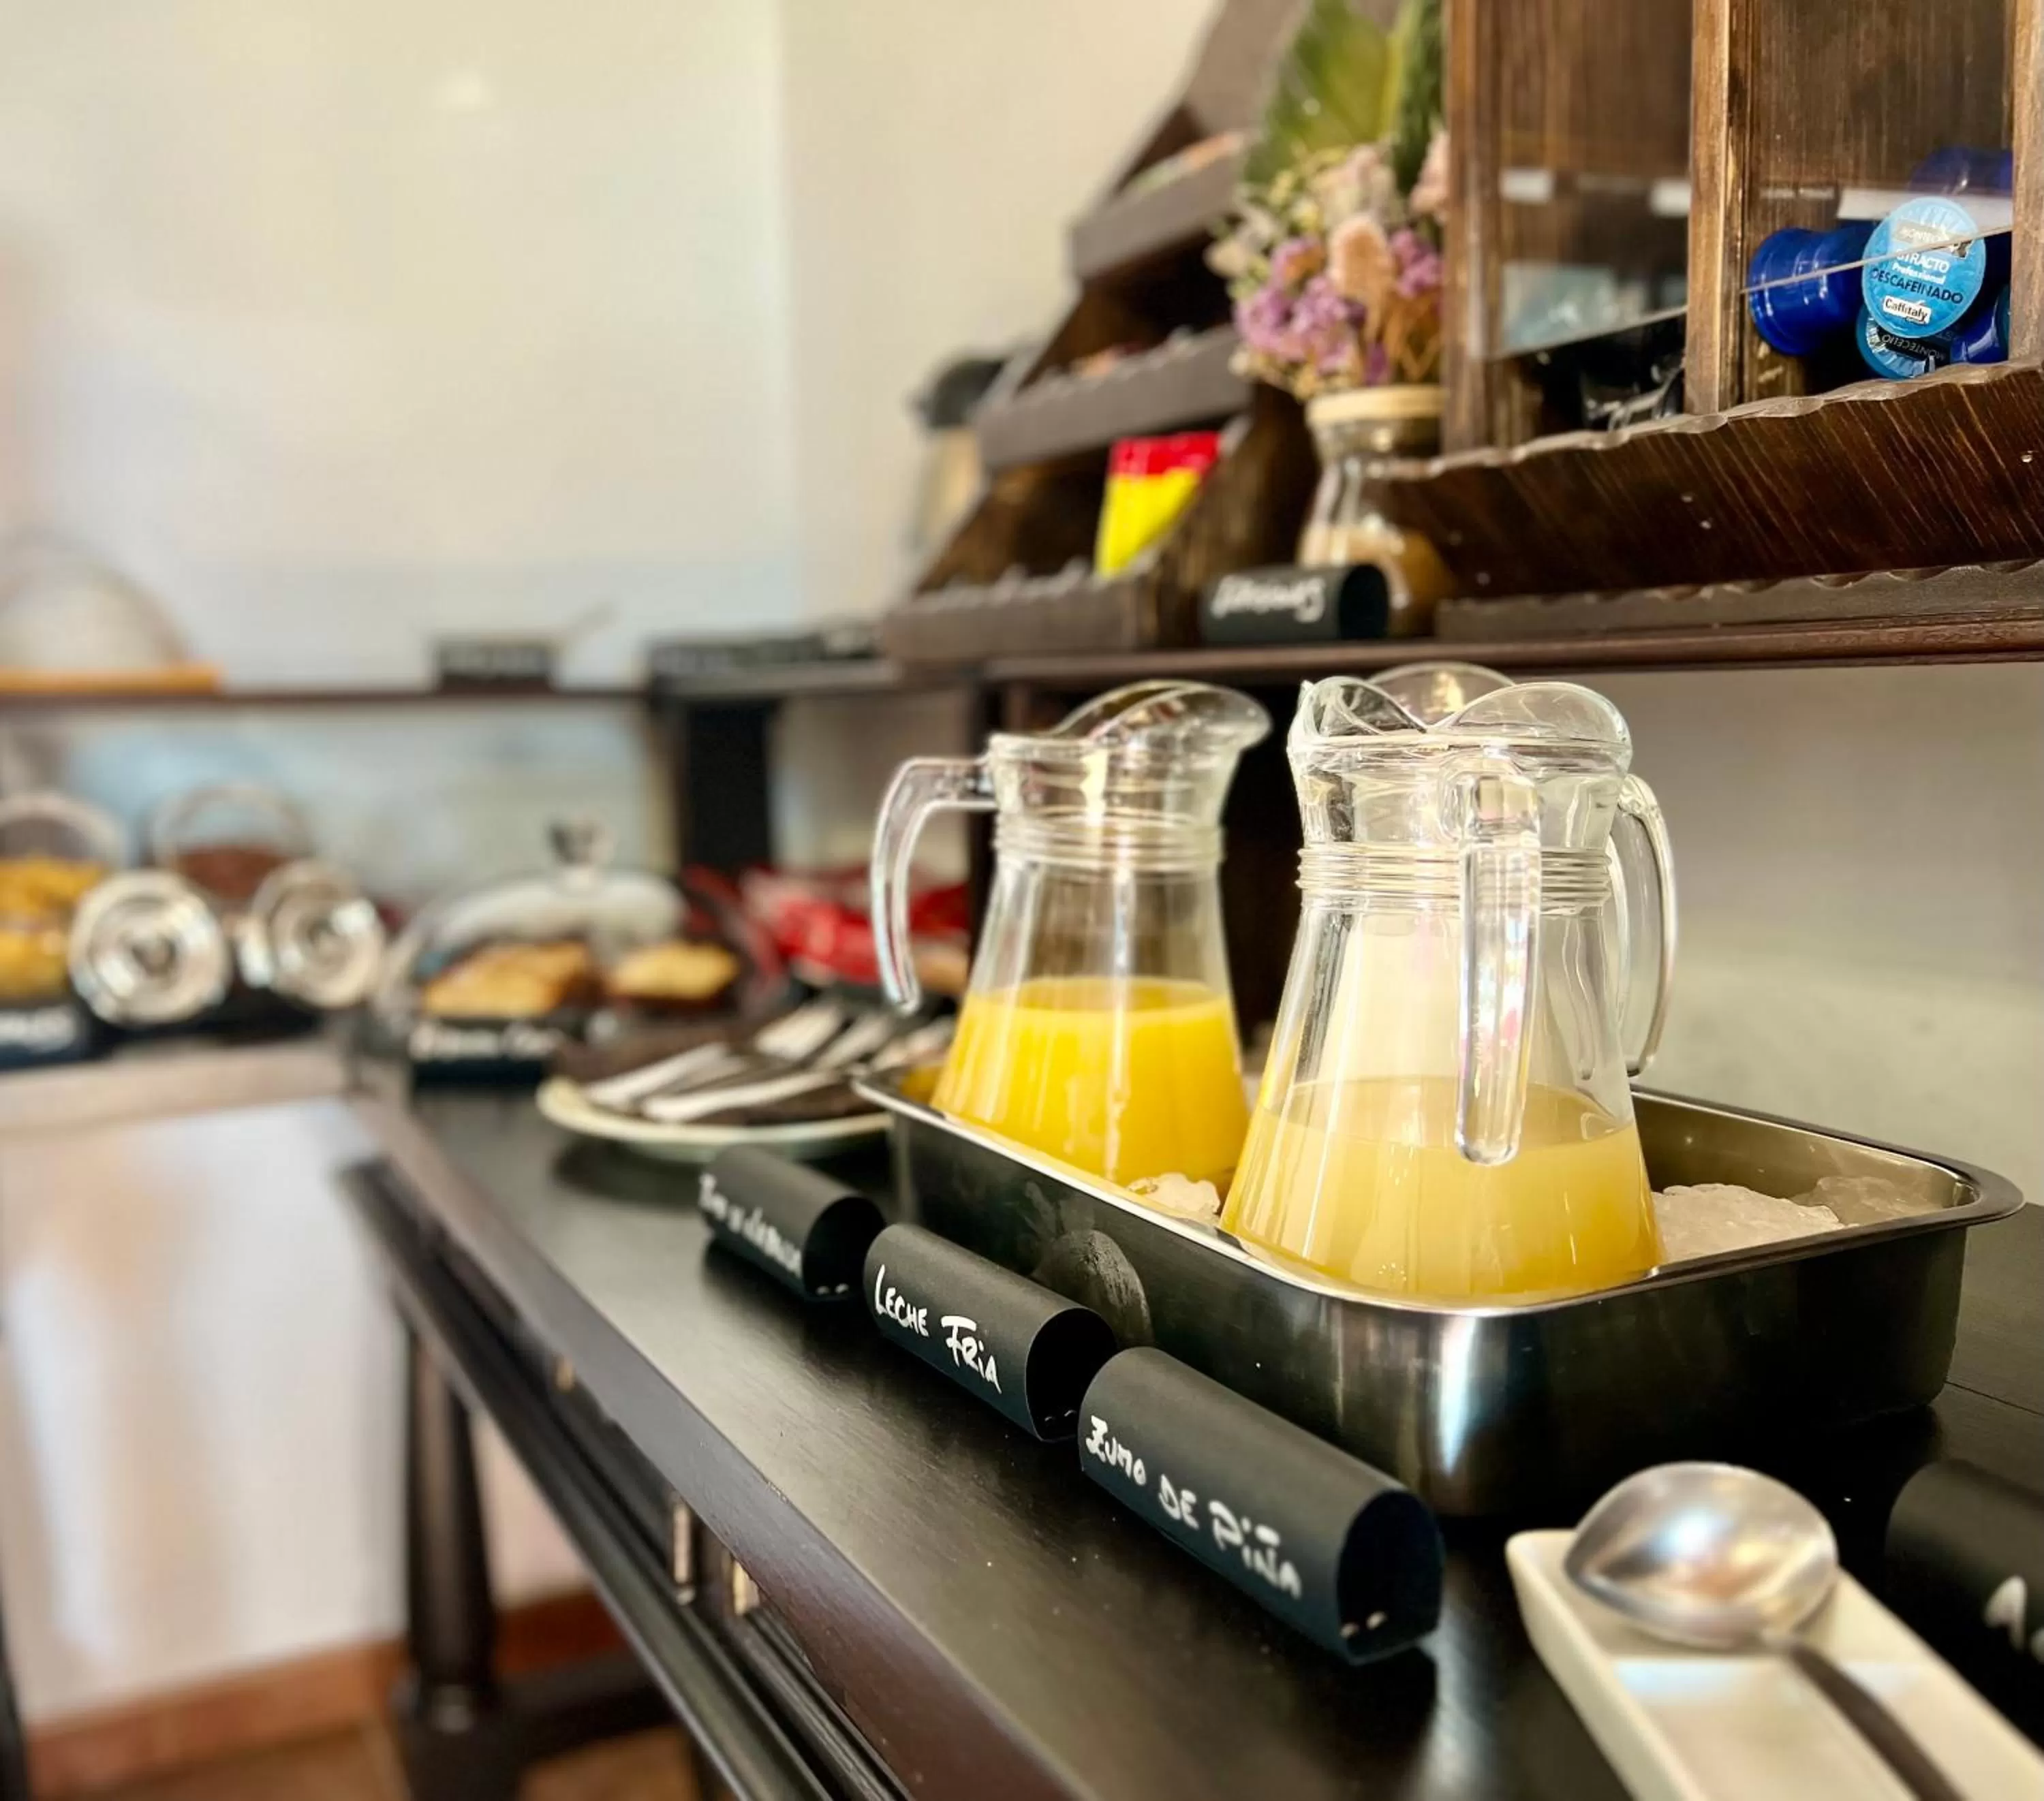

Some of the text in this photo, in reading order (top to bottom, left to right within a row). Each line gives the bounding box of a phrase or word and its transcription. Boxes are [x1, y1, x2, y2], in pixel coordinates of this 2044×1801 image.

[1871, 267, 1964, 304] DESCAFEINADO
[1885, 298, 1928, 322] Caffitaly
[873, 1264, 929, 1338] LECHE
[1159, 1473, 1200, 1531] DE
